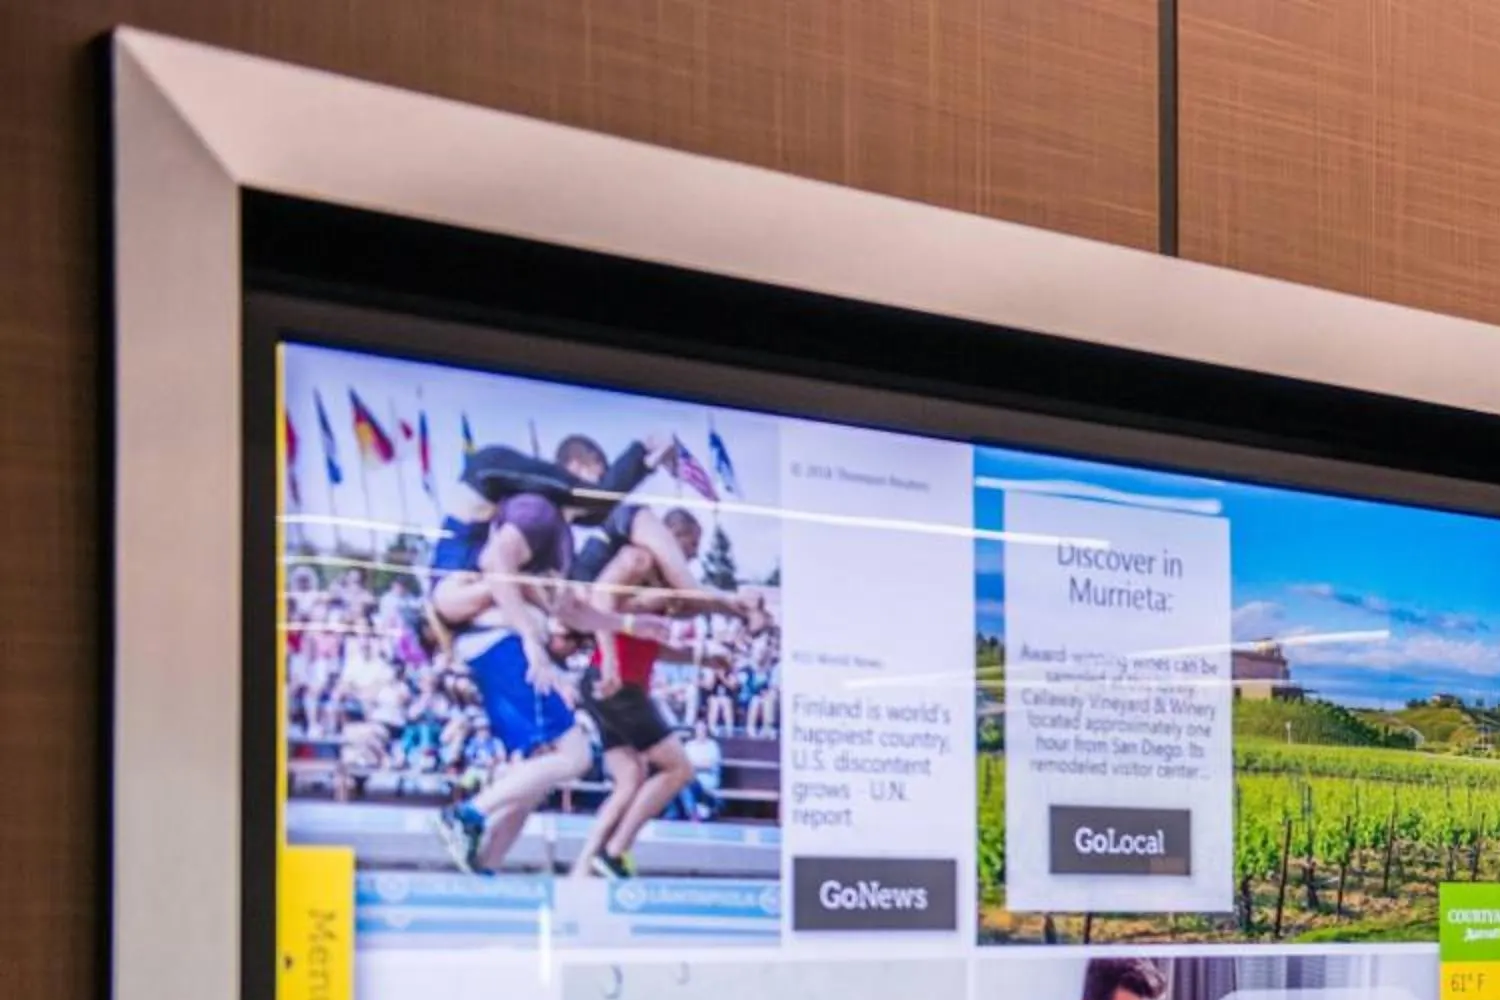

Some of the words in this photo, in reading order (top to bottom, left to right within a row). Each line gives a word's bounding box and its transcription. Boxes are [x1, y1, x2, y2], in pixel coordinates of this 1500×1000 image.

[1057, 541, 1157, 575] Discover
[1163, 549, 1183, 578] in
[1174, 658, 1197, 675] can
[1201, 656, 1219, 676] be
[792, 693, 861, 720] Finland
[866, 697, 881, 721] is
[886, 699, 952, 726] world's
[1088, 690, 1150, 717] Vineyard
[1154, 696, 1166, 715] &
[1170, 697, 1216, 722] Winery
[792, 722, 874, 752] happiest
[1027, 710, 1081, 731] located
[1085, 716, 1183, 742] approximately
[1187, 722, 1211, 738] one
[1036, 735, 1070, 752] hour
[1074, 734, 1108, 753] from
[1112, 737, 1138, 755] San
[833, 750, 931, 778] discontent
[1029, 756, 1108, 777] remodeled
[1112, 759, 1153, 777] visitor
[792, 781, 851, 803] grows
[792, 807, 853, 831] report
[1075, 826, 1166, 855] GoLocal
[819, 880, 930, 911] GoNews
[1477, 972, 1487, 992] F
